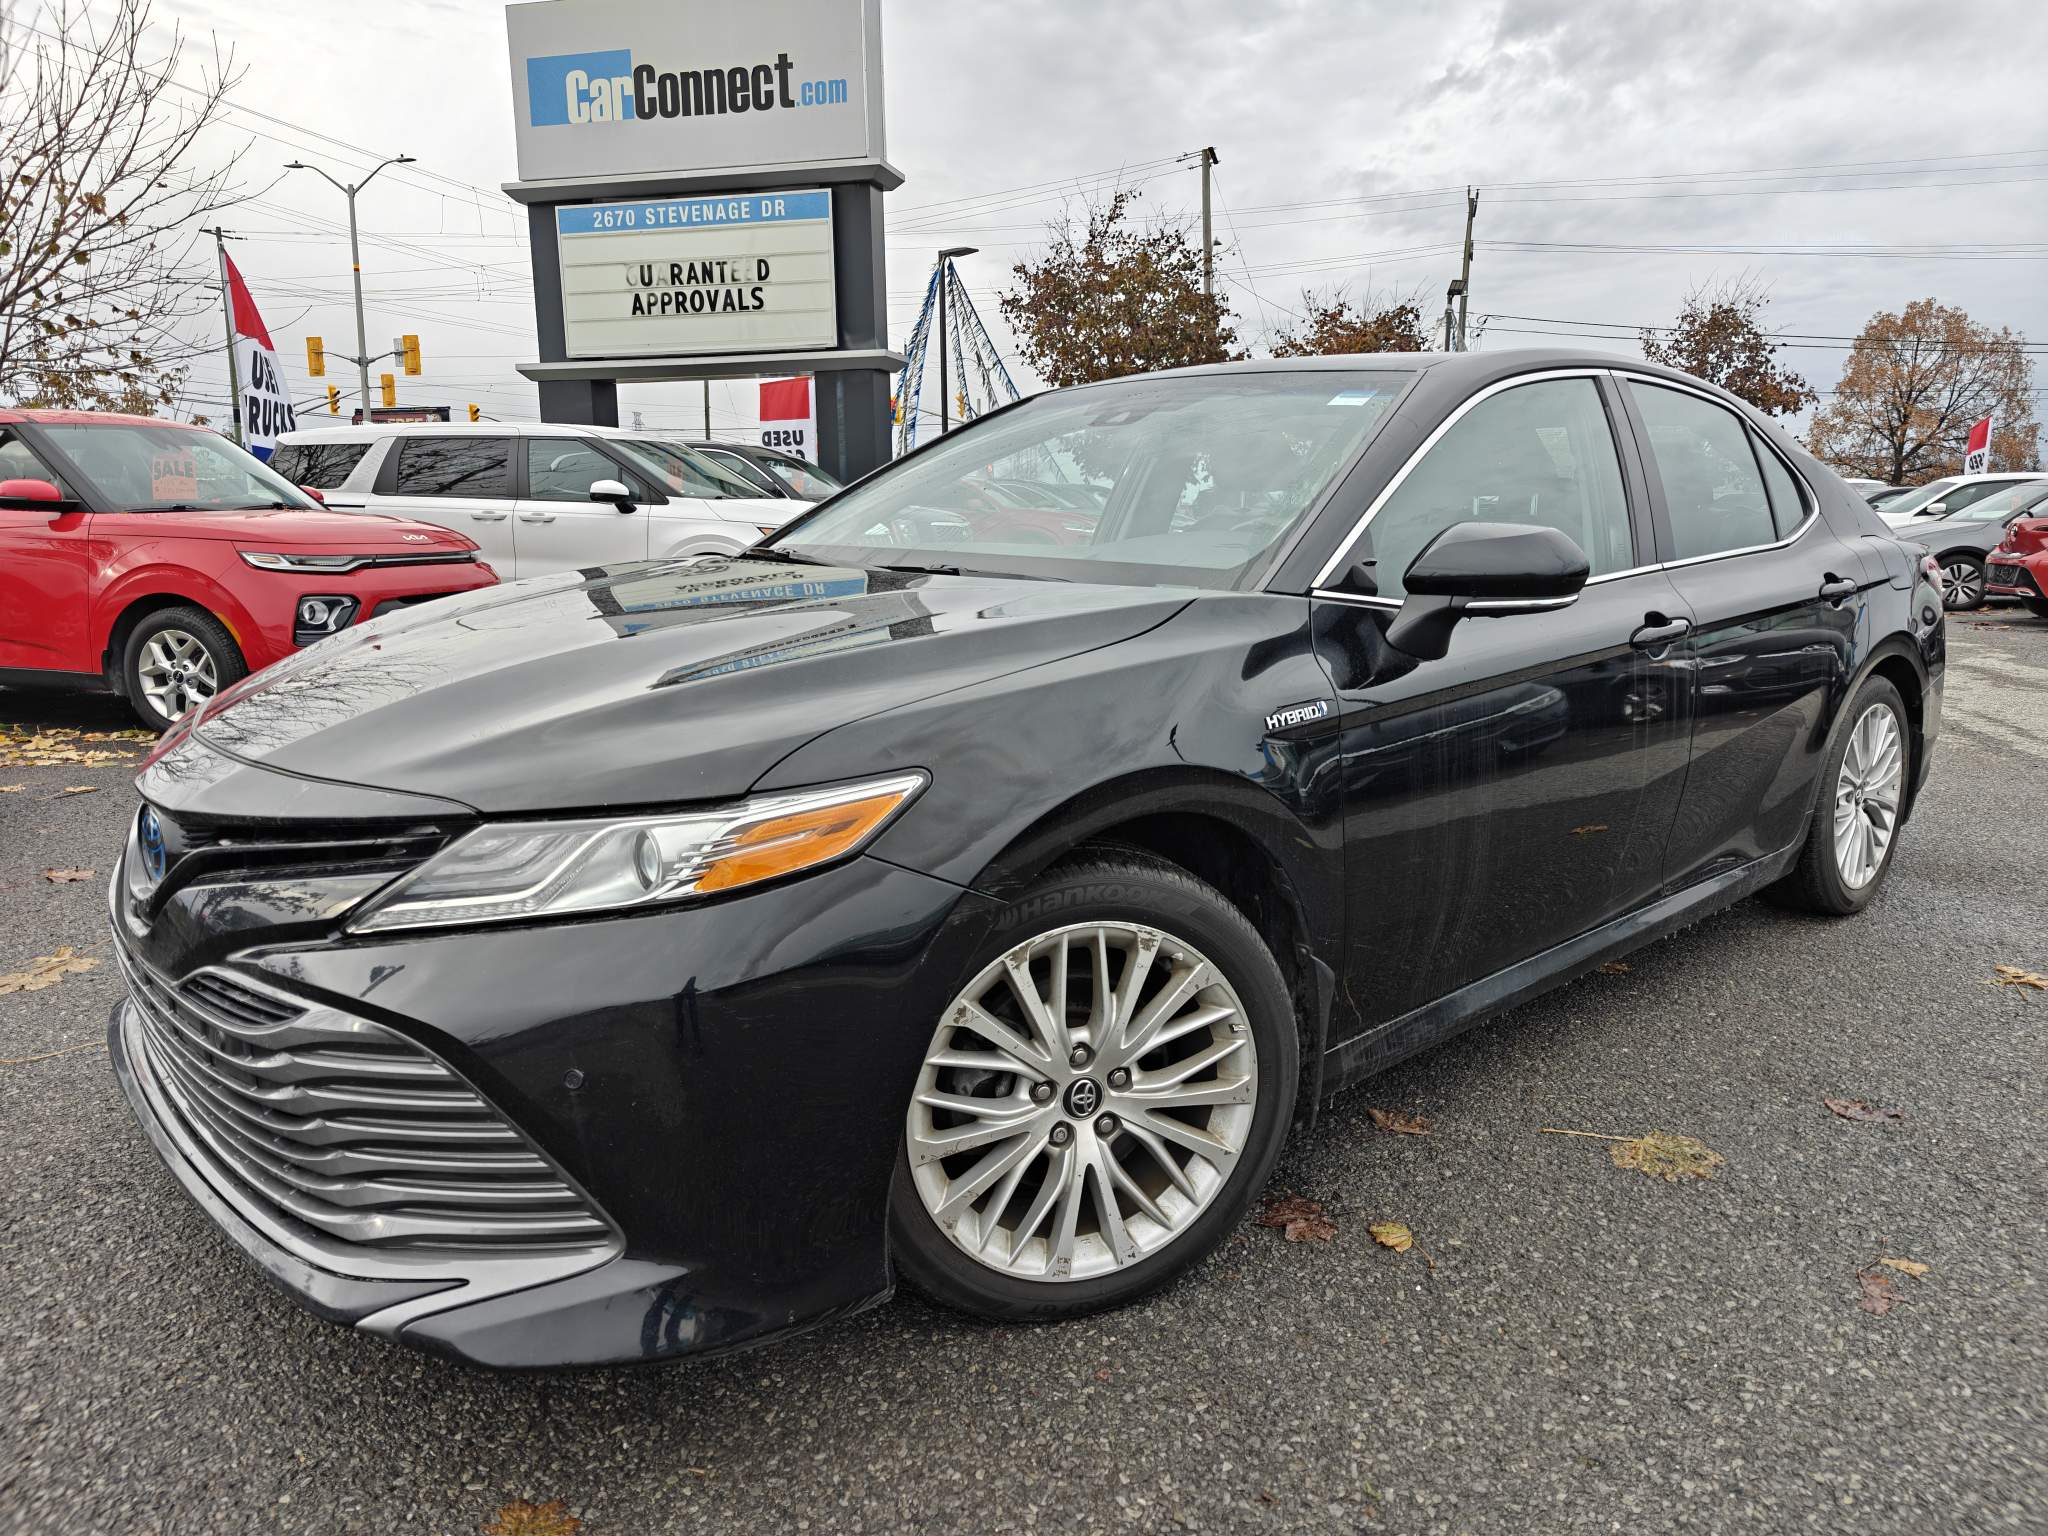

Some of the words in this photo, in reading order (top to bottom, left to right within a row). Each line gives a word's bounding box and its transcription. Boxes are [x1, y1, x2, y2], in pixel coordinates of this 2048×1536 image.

[565, 53, 848, 124] CarConnect.com
[593, 210, 635, 228] 2670
[645, 201, 750, 225] STEVENAGE
[761, 199, 786, 217] DR
[632, 287, 764, 315] APPROVALS
[245, 394, 296, 437] RUCKS
[153, 461, 194, 480] SALE
[1265, 705, 1320, 730] HYBRID
